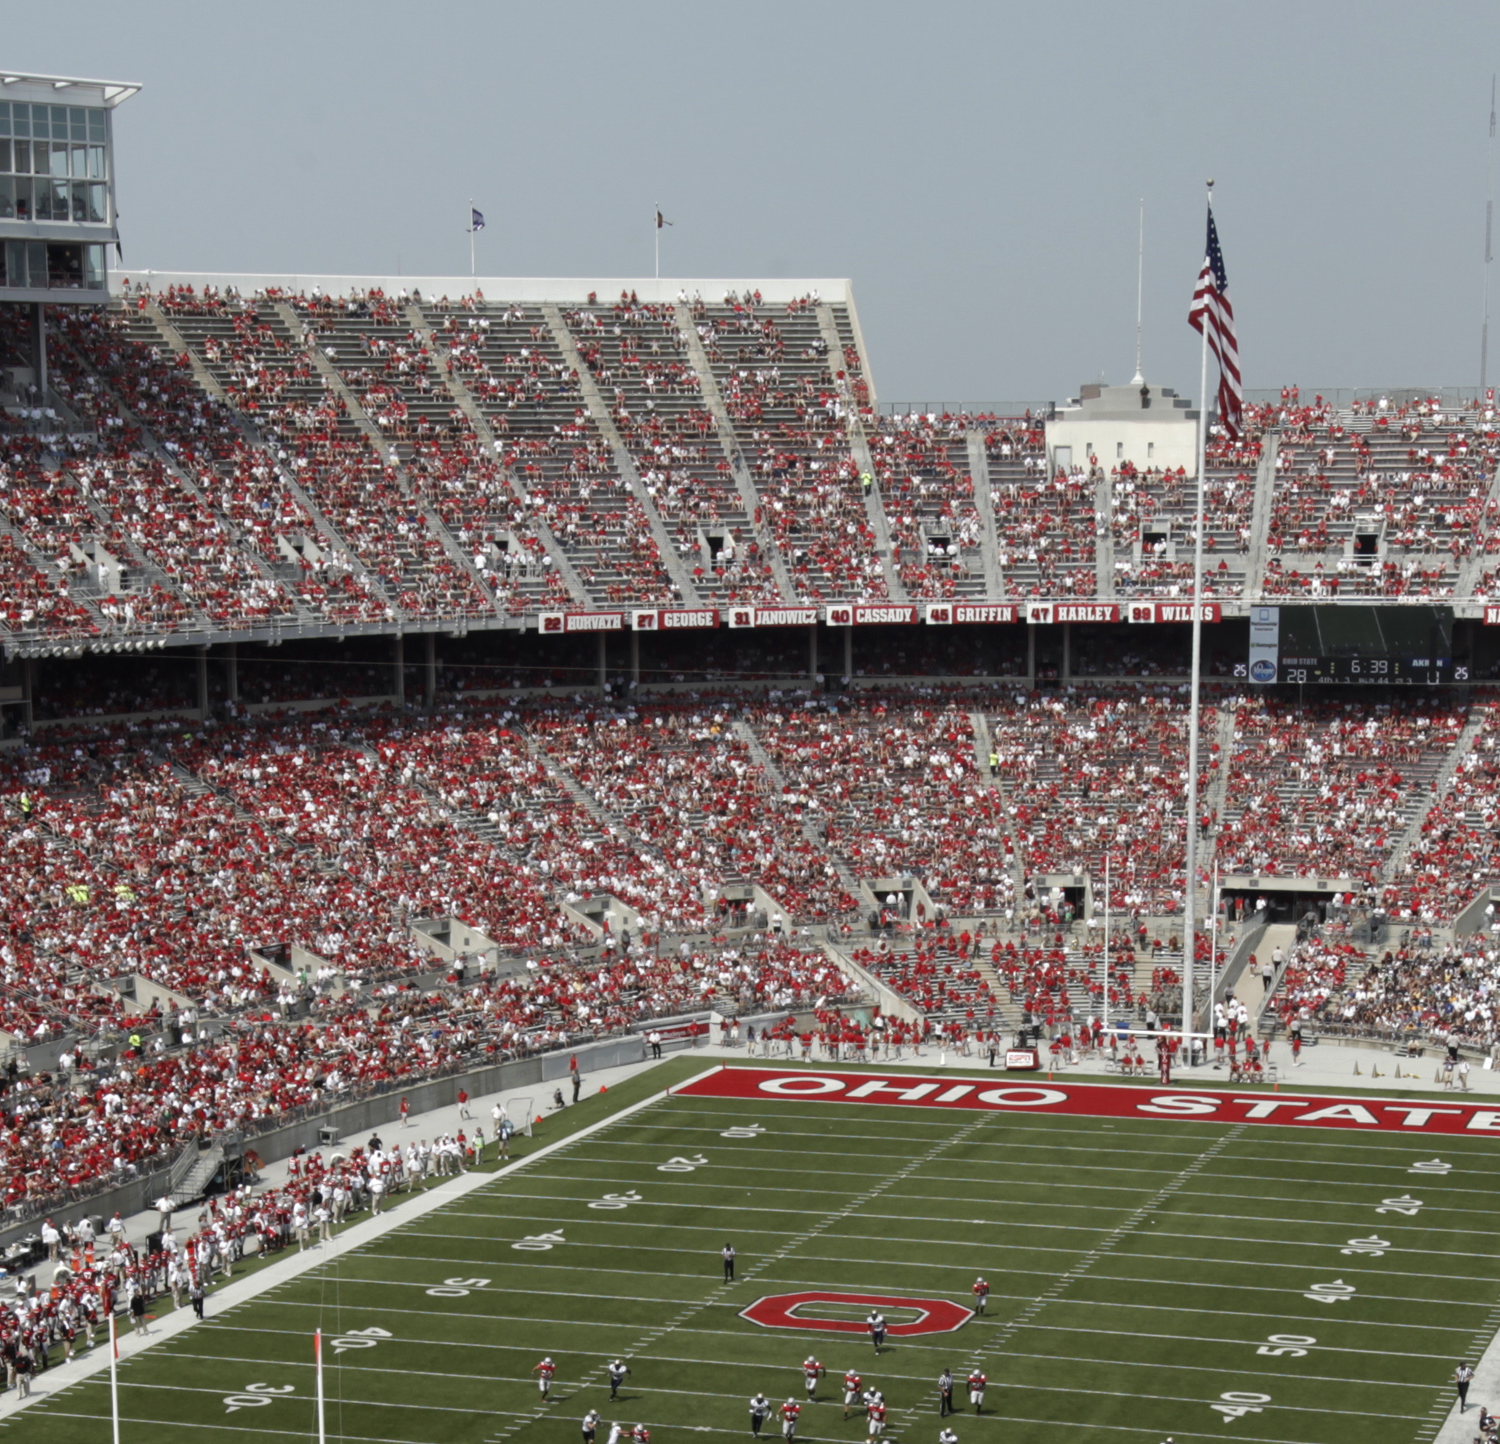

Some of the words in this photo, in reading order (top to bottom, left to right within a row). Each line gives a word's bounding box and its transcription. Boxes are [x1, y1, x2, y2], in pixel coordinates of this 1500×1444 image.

[663, 611, 713, 627] GEORGE
[755, 608, 817, 625] JANOWICZ
[830, 609, 849, 623] 40
[856, 606, 913, 623] CASSADY
[931, 608, 949, 622] 45
[956, 606, 1013, 622] GRIFFIN
[1030, 607, 1050, 622] 47
[1058, 606, 1113, 622] HARLEY
[1132, 607, 1151, 621] 99
[1234, 664, 1247, 677] 25
[1351, 660, 1388, 673] 6:39
[1412, 659, 1443, 667] AKRN
[1286, 669, 1307, 683] 28
[1454, 666, 1468, 680] 25
[757, 1075, 1069, 1107] OHIO
[721, 1125, 766, 1138] 10
[657, 1156, 709, 1171] 20
[1407, 1160, 1453, 1175] 10
[588, 1193, 642, 1210] 30
[1375, 1197, 1424, 1216] 20
[511, 1232, 565, 1251] 40
[1340, 1238, 1392, 1257] 30
[425, 1277, 491, 1297] 50
[1303, 1283, 1357, 1304] 40
[331, 1326, 394, 1349] 40
[1256, 1334, 1317, 1358] 50
[222, 1382, 296, 1408] 30
[1210, 1391, 1272, 1417] 40
